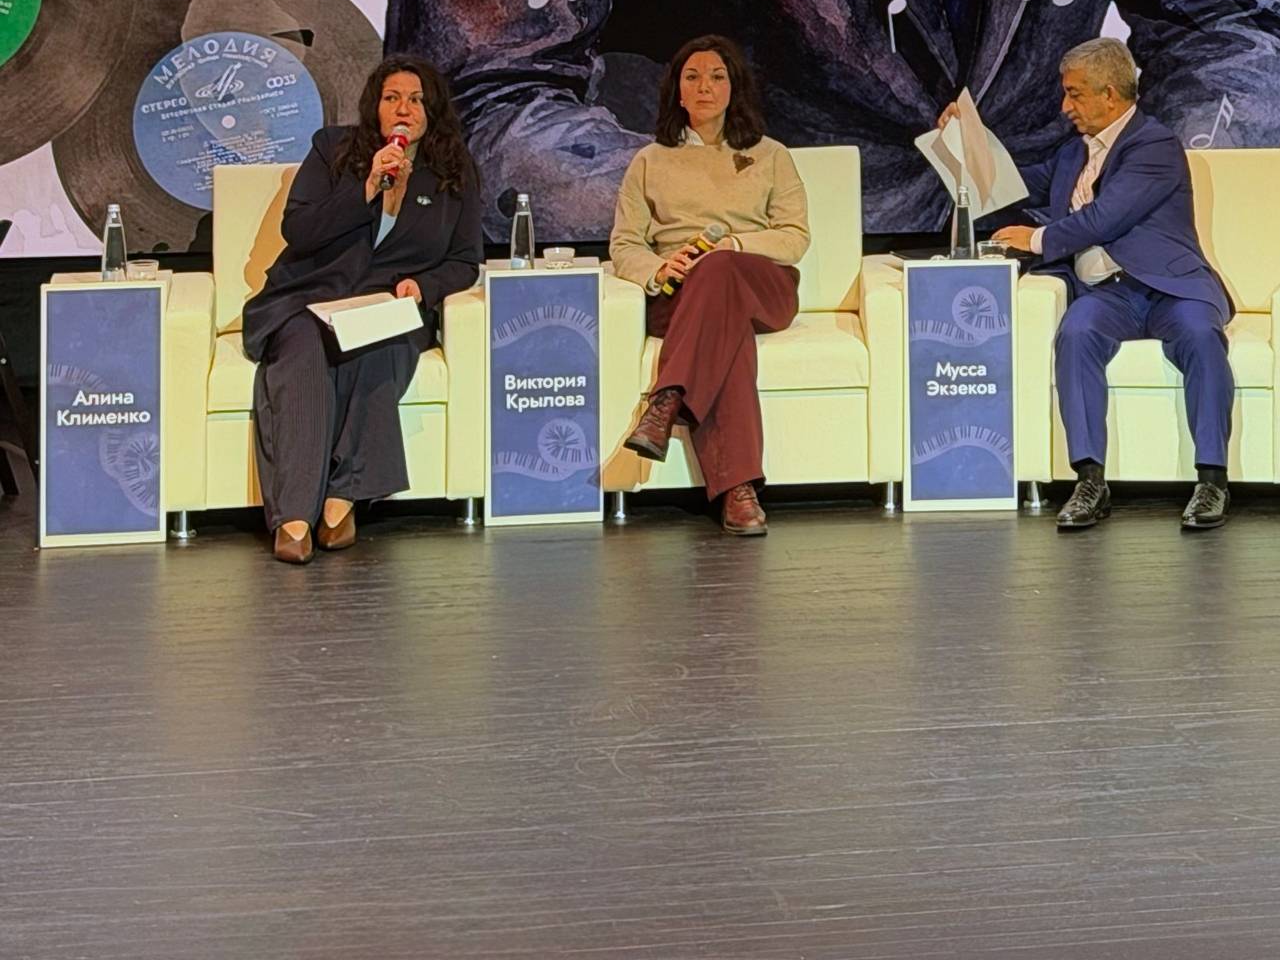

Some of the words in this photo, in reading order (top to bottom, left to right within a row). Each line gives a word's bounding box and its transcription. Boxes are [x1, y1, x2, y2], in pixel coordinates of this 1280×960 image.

[153, 38, 277, 85] МЕЛОДИЯ
[935, 362, 987, 381] Мусса
[504, 374, 587, 392] Виктория
[926, 380, 997, 397] Экзеков
[72, 390, 135, 406] Алина
[505, 393, 585, 412] Крылова
[56, 410, 152, 426] Клименко
